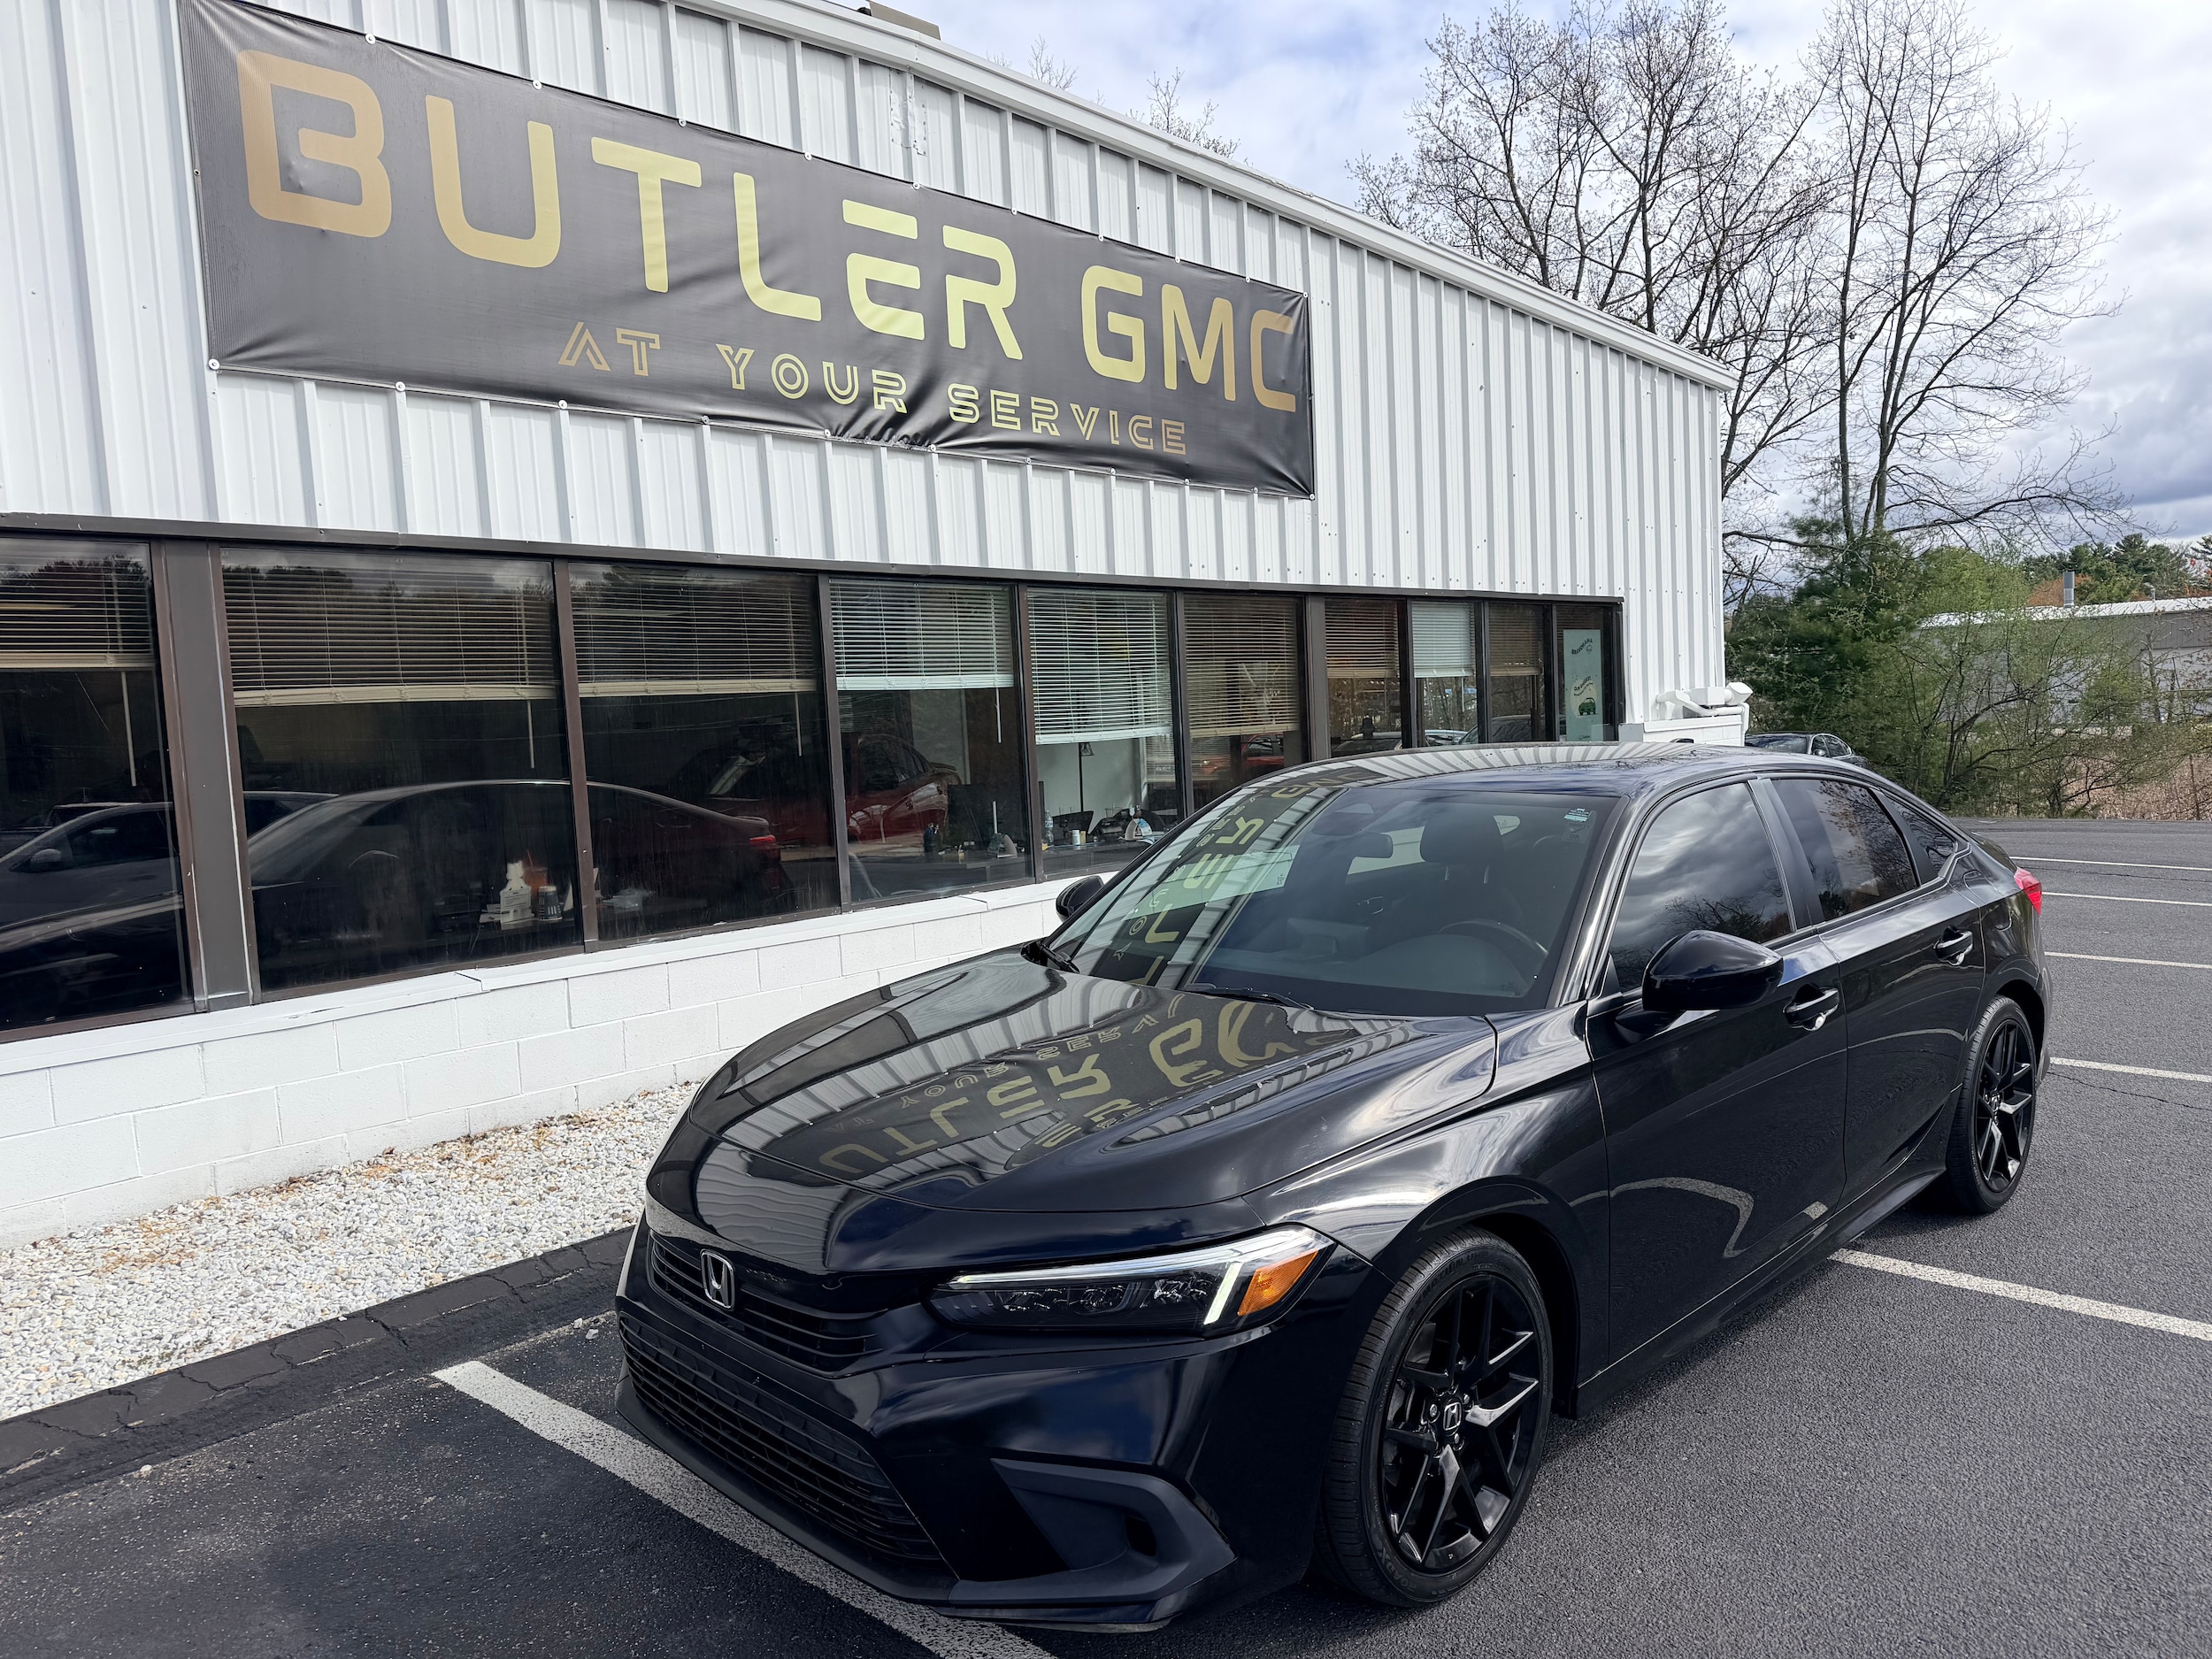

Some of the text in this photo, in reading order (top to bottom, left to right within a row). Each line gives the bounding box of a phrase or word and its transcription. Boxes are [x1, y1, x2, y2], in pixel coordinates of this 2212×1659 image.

[236, 49, 1296, 412] BUTLER GMC
[557, 321, 1187, 455] AT YOUR SERVICE
